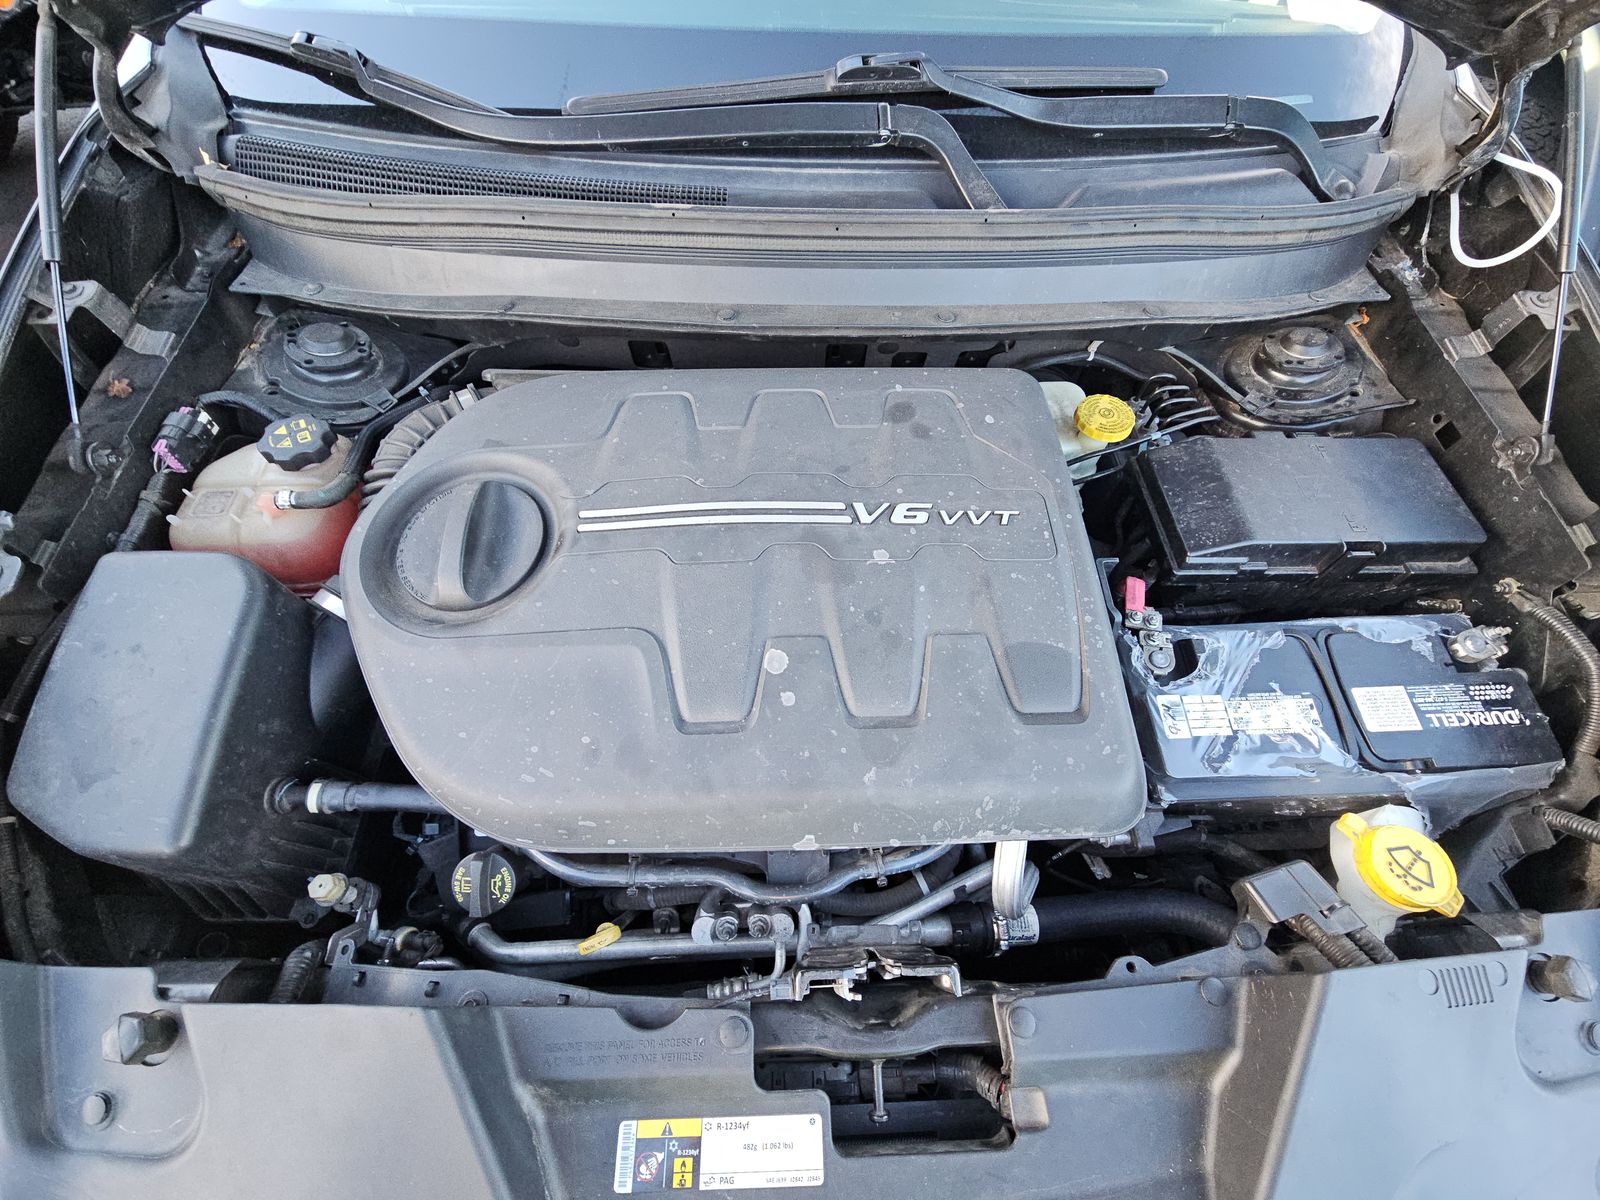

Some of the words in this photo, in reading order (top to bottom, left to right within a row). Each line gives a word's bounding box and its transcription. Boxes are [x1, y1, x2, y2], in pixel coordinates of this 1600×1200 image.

[851, 502, 933, 525] V6
[938, 510, 1020, 526] VVT
[1425, 709, 1520, 727] DURACELL
[455, 867, 466, 880] SAE
[501, 867, 511, 893] ENGINE
[454, 881, 464, 903] 5W-20
[498, 894, 509, 904] OIL
[608, 1040, 634, 1050] PANEL
[639, 1039, 656, 1049] FOR
[658, 1038, 692, 1049] ACCESS
[616, 1054, 629, 1064] ON
[632, 1053, 657, 1064] SOME
[660, 1052, 704, 1063] VEHICLES
[716, 1121, 750, 1131] R-1234yf
[677, 1148, 699, 1157] R-1234yf
[743, 1143, 758, 1151] 482g
[782, 1142, 794, 1150] lbs)
[719, 1176, 735, 1185] PAG
